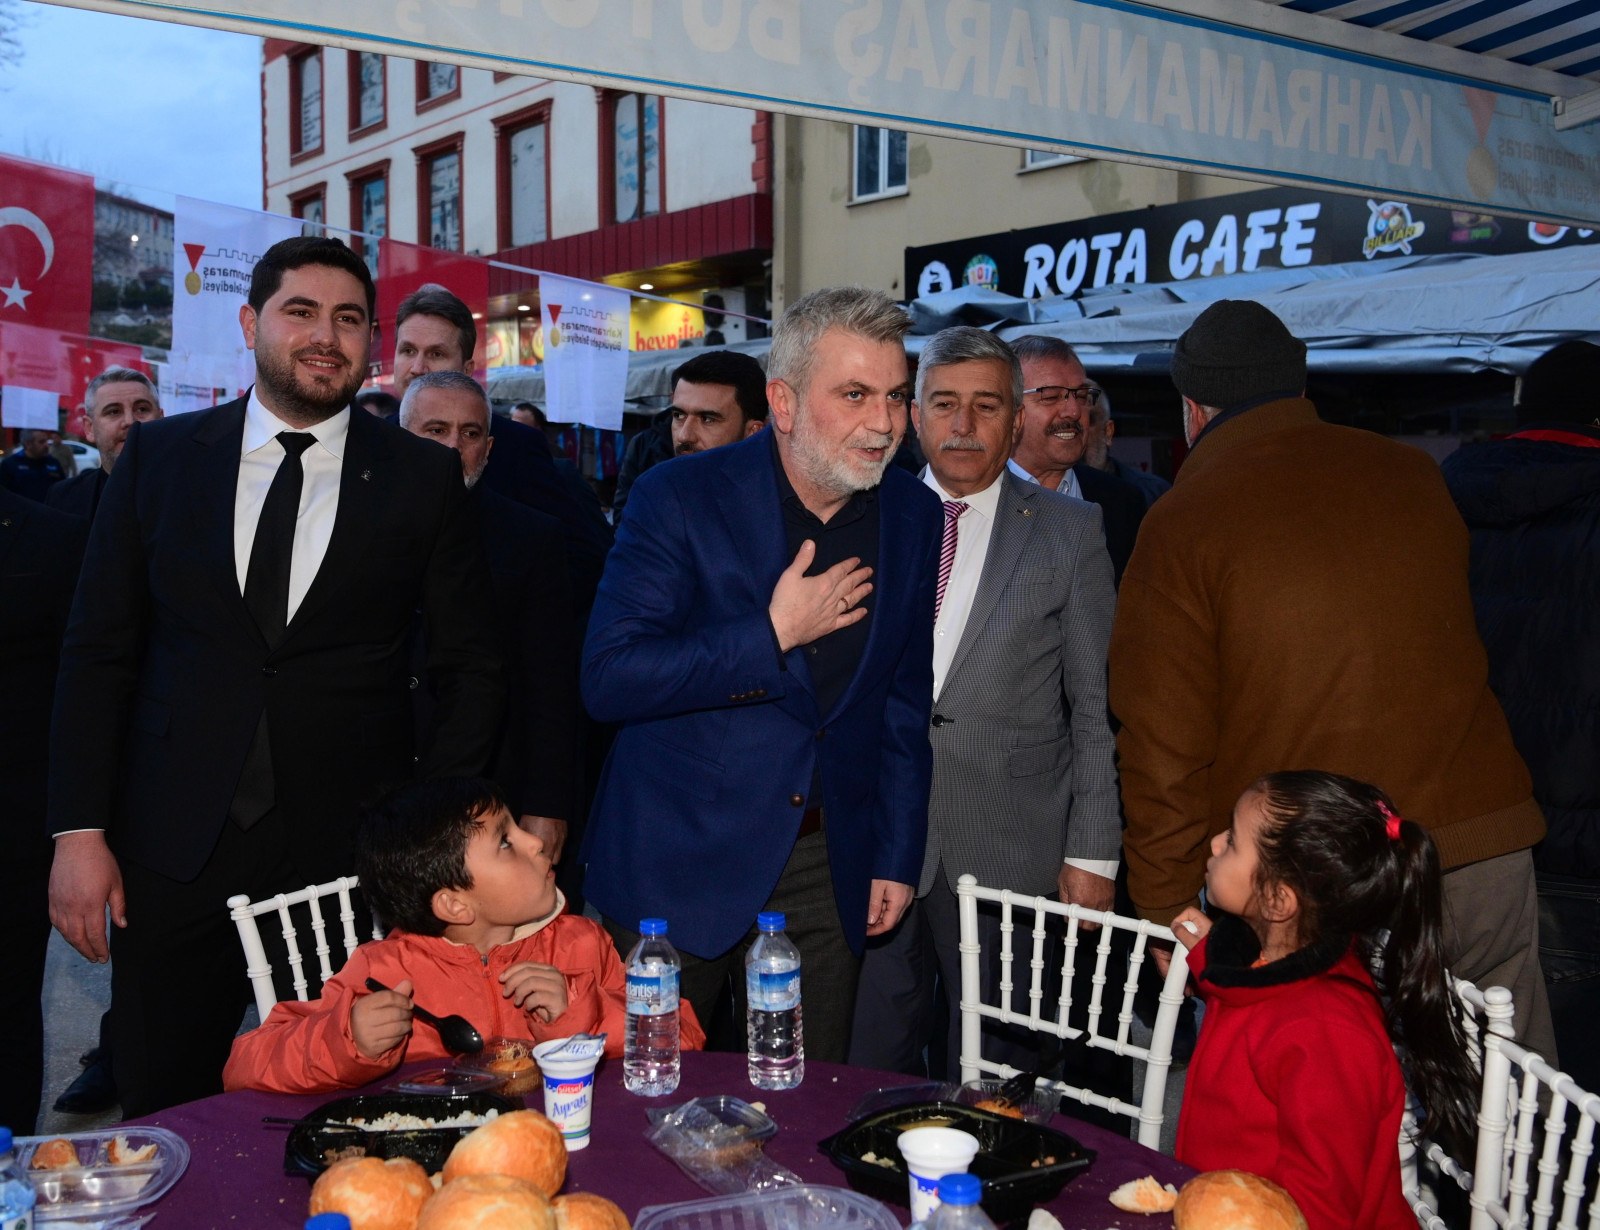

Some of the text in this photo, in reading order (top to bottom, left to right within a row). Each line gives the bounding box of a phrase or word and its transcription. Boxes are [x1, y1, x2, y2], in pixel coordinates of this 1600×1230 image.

[1023, 202, 1321, 299] ROTA CAFE
[553, 1094, 588, 1119] Ayran
